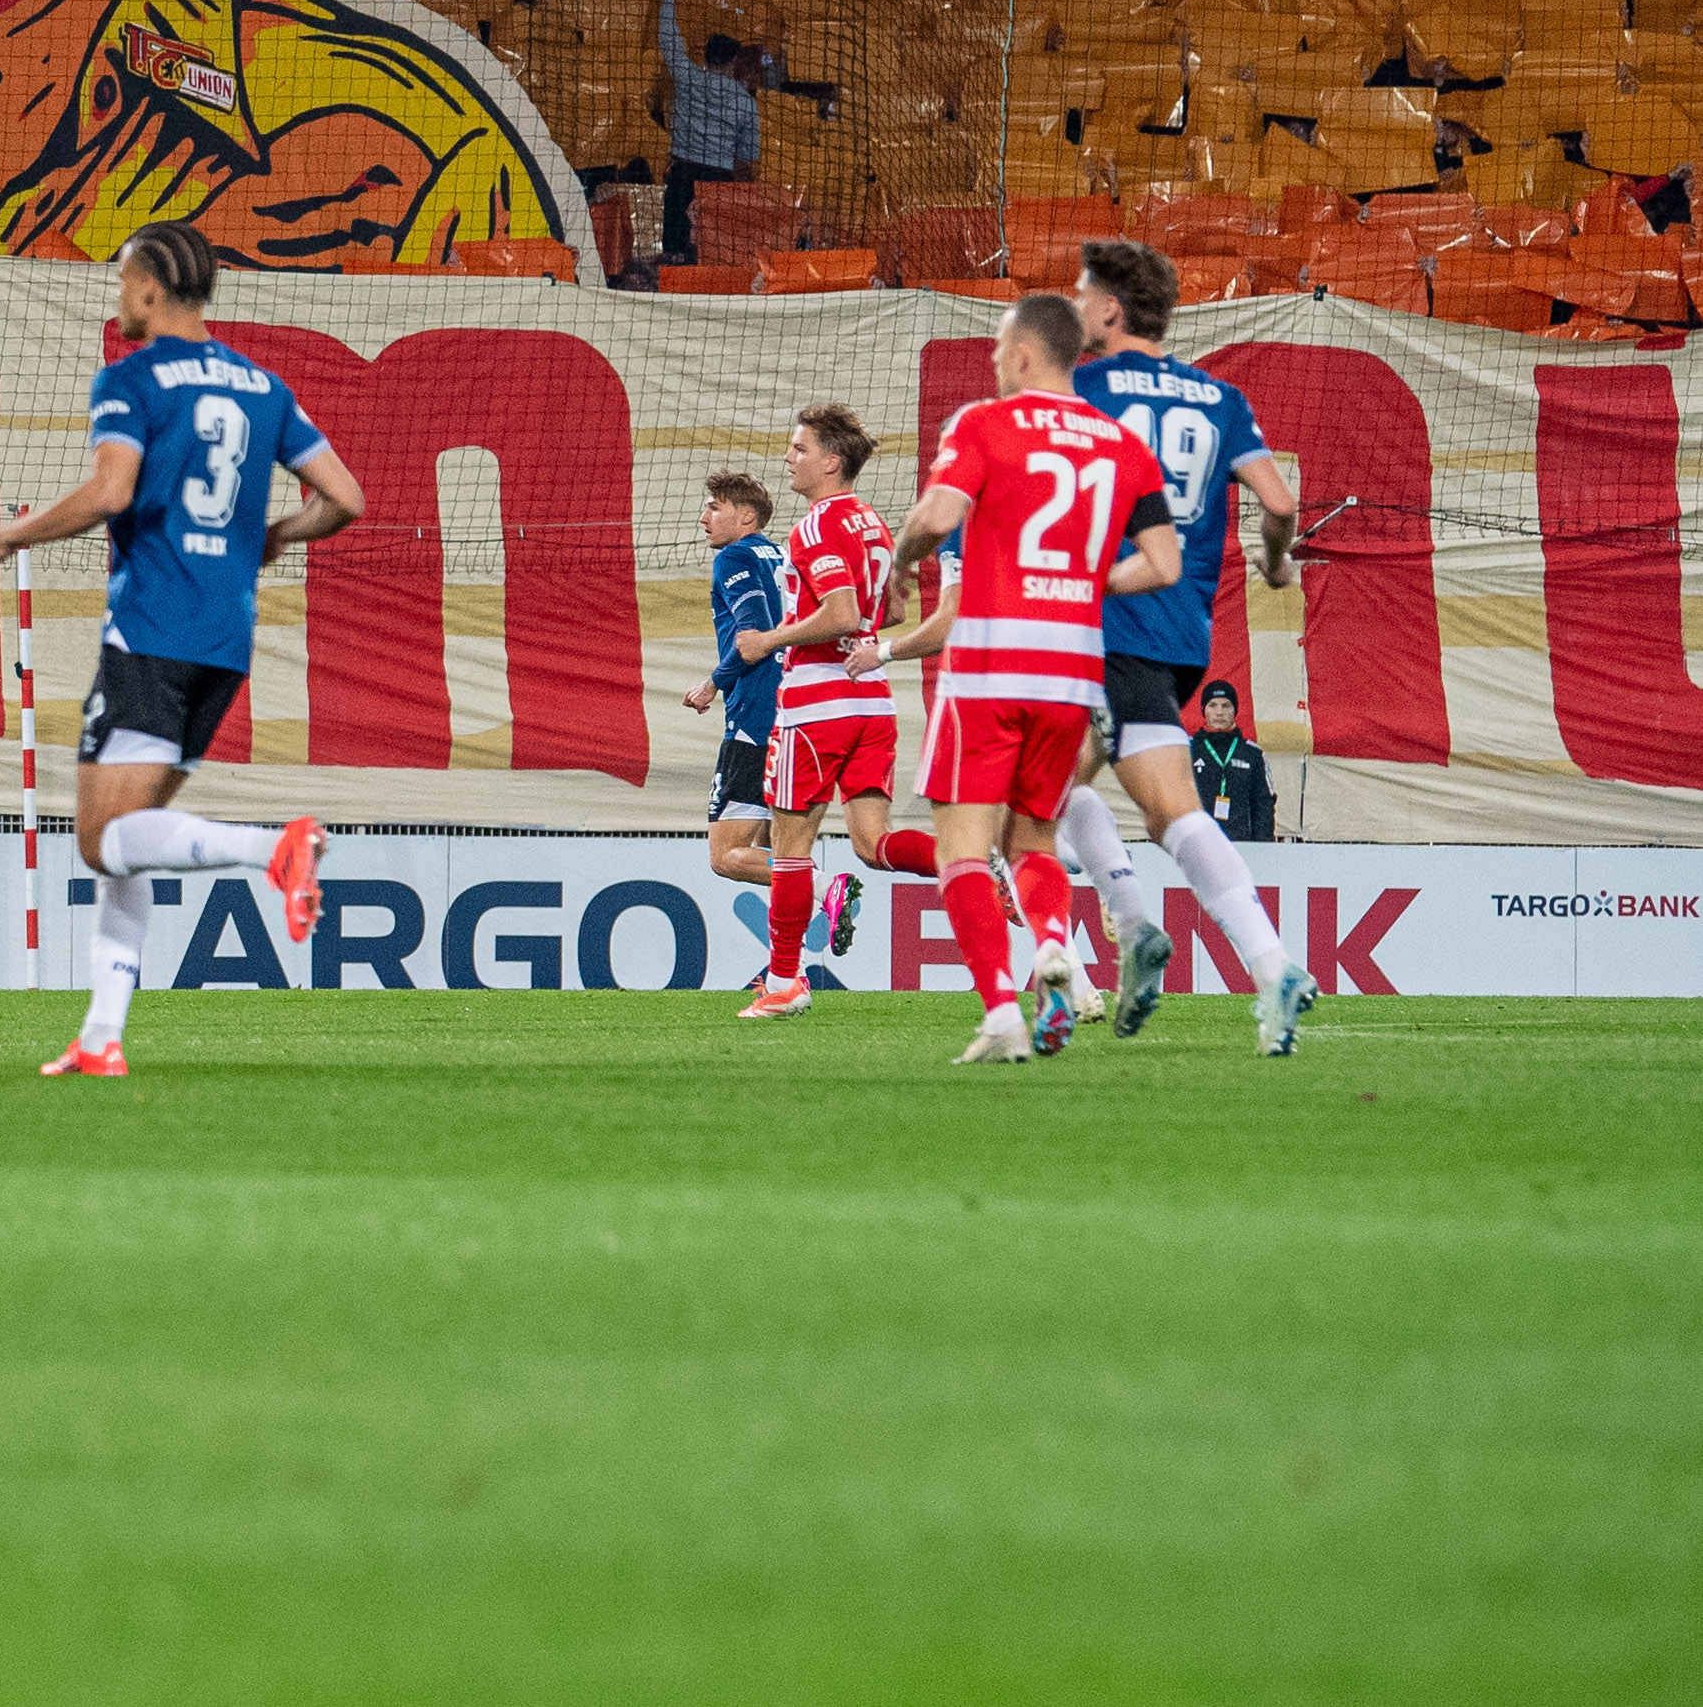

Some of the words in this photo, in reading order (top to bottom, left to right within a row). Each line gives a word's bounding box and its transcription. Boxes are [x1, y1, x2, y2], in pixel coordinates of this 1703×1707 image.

[187, 64, 234, 100] UNION
[152, 357, 272, 394] BIELEFELD
[1106, 369, 1224, 406] BIELEFELD
[181, 394, 251, 529] 3
[1017, 451, 1117, 574] 21
[1491, 894, 1590, 917] TARGO
[1617, 895, 1700, 918] BANK
